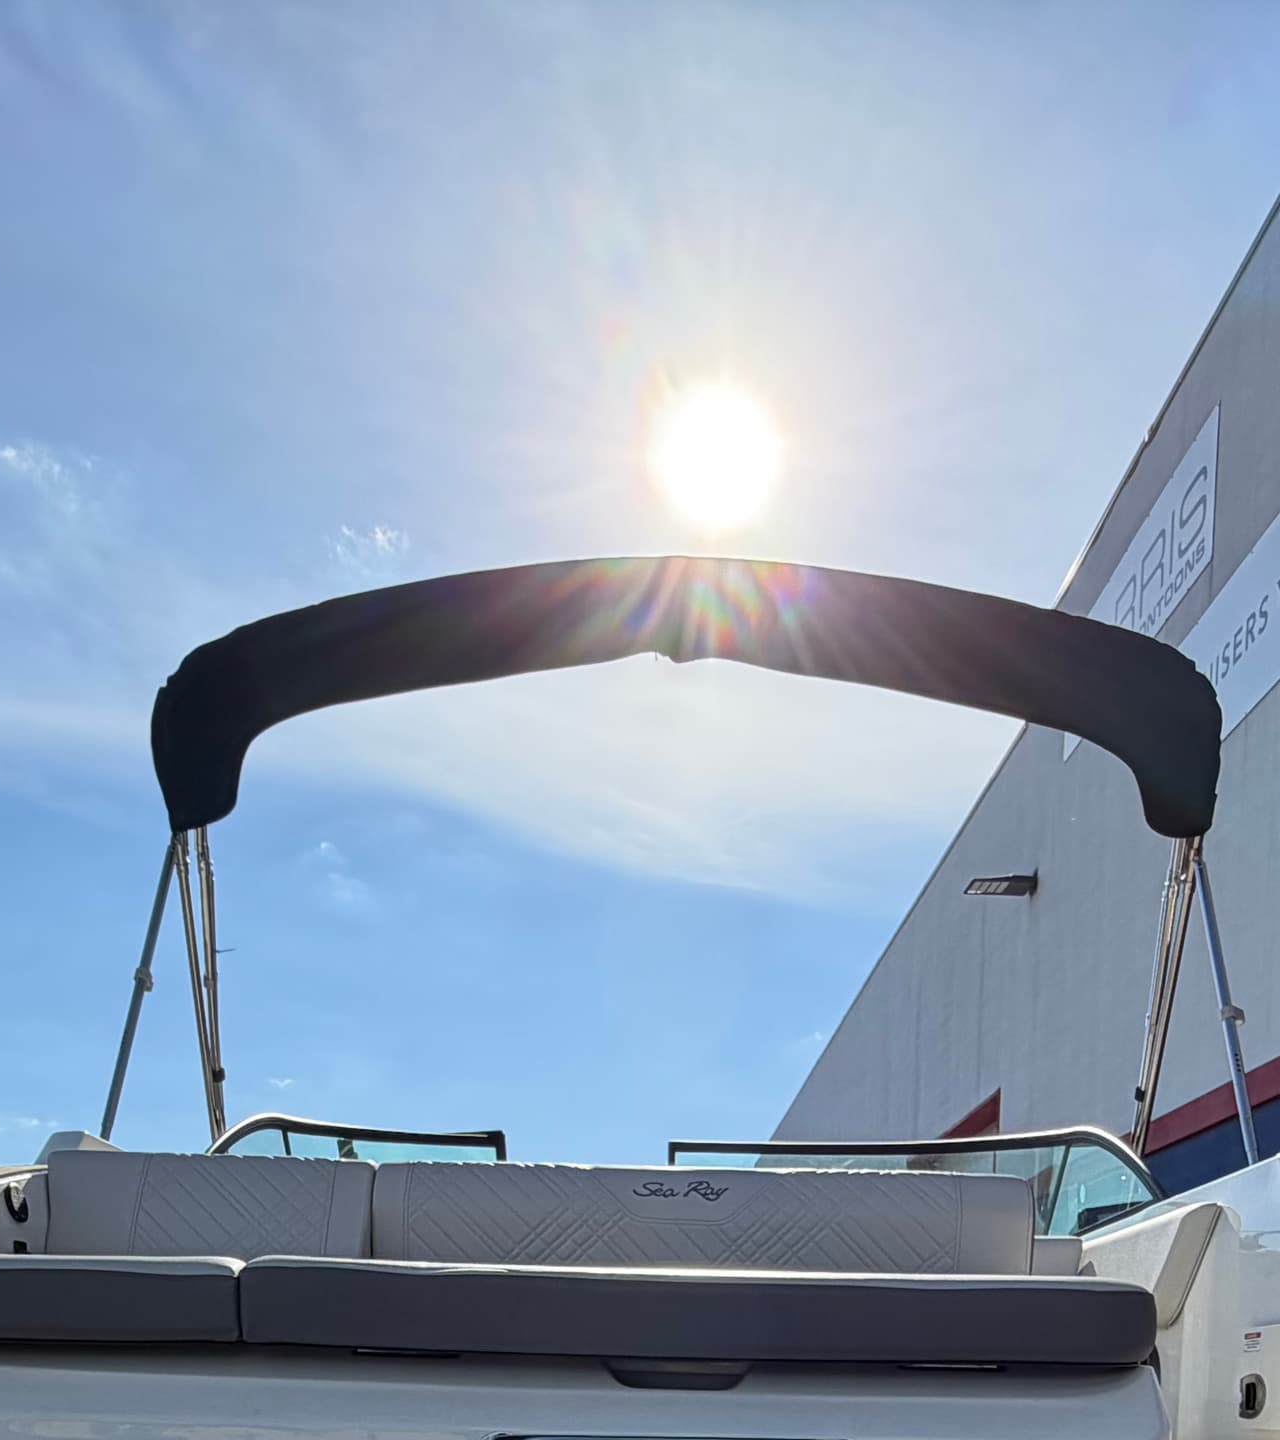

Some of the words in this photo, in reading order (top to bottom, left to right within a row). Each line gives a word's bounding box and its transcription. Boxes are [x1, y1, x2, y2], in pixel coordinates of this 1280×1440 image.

[1114, 464, 1208, 631] RRIS
[1139, 537, 1206, 634] NTOONS
[632, 1181, 680, 1199] Sea
[683, 1180, 729, 1202] Ray
